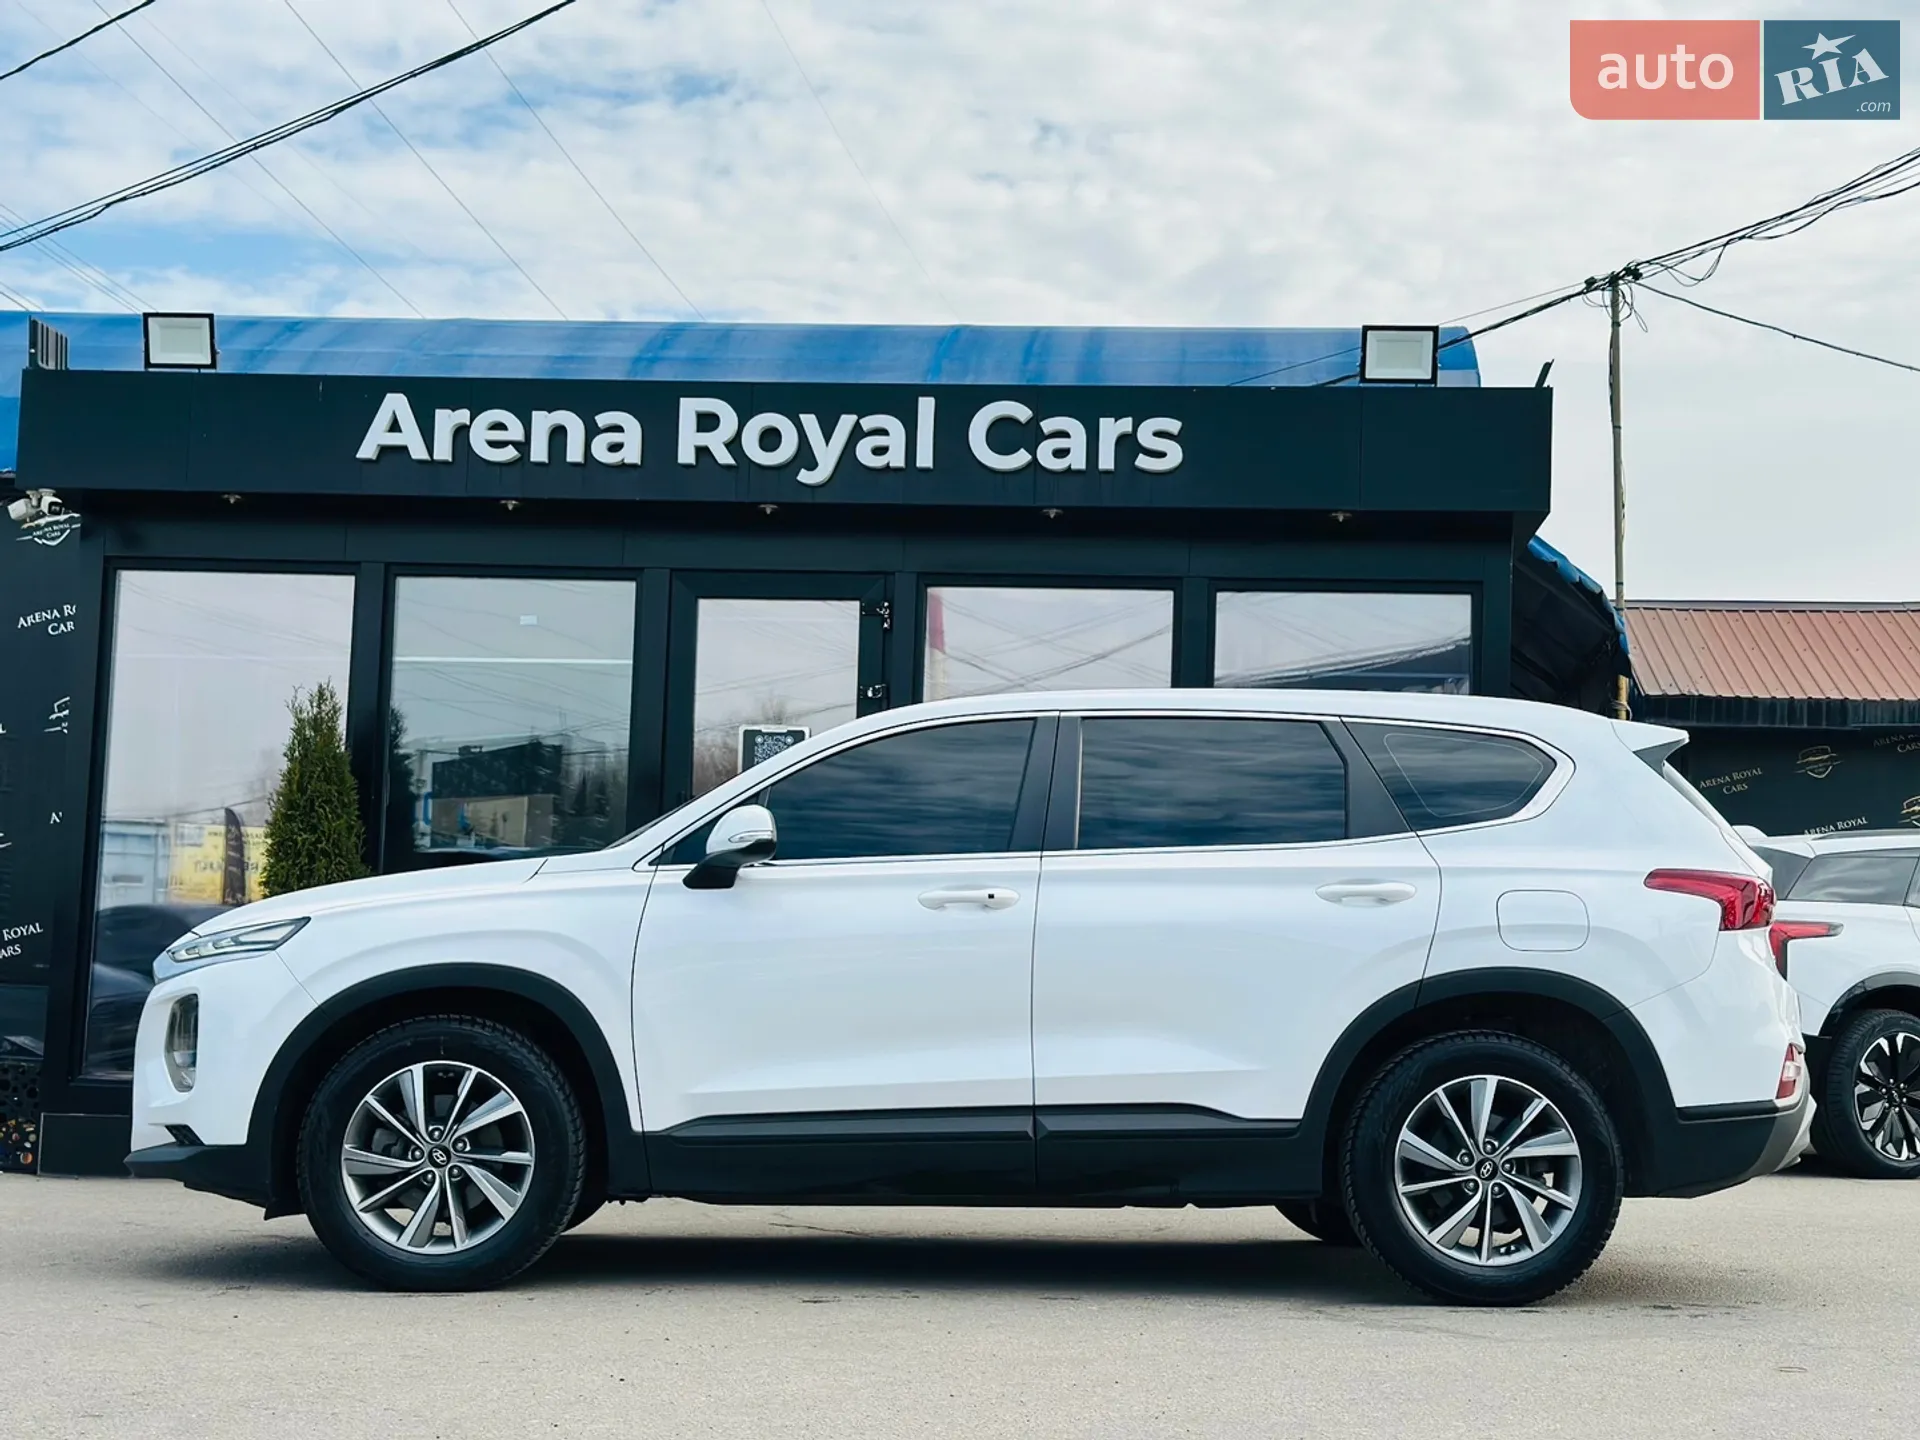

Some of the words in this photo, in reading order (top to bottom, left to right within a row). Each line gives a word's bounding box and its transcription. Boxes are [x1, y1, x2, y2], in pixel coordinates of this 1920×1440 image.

[355, 393, 643, 465] Arena
[678, 396, 936, 487] Royal
[968, 400, 1184, 473] Cars
[17, 608, 61, 629] ARENA
[1699, 775, 1731, 789] ARENA
[1731, 767, 1763, 780] ROYAL
[1722, 783, 1749, 795] CARS
[1836, 816, 1868, 830] ROYAL
[2, 922, 44, 941] ROYAL
